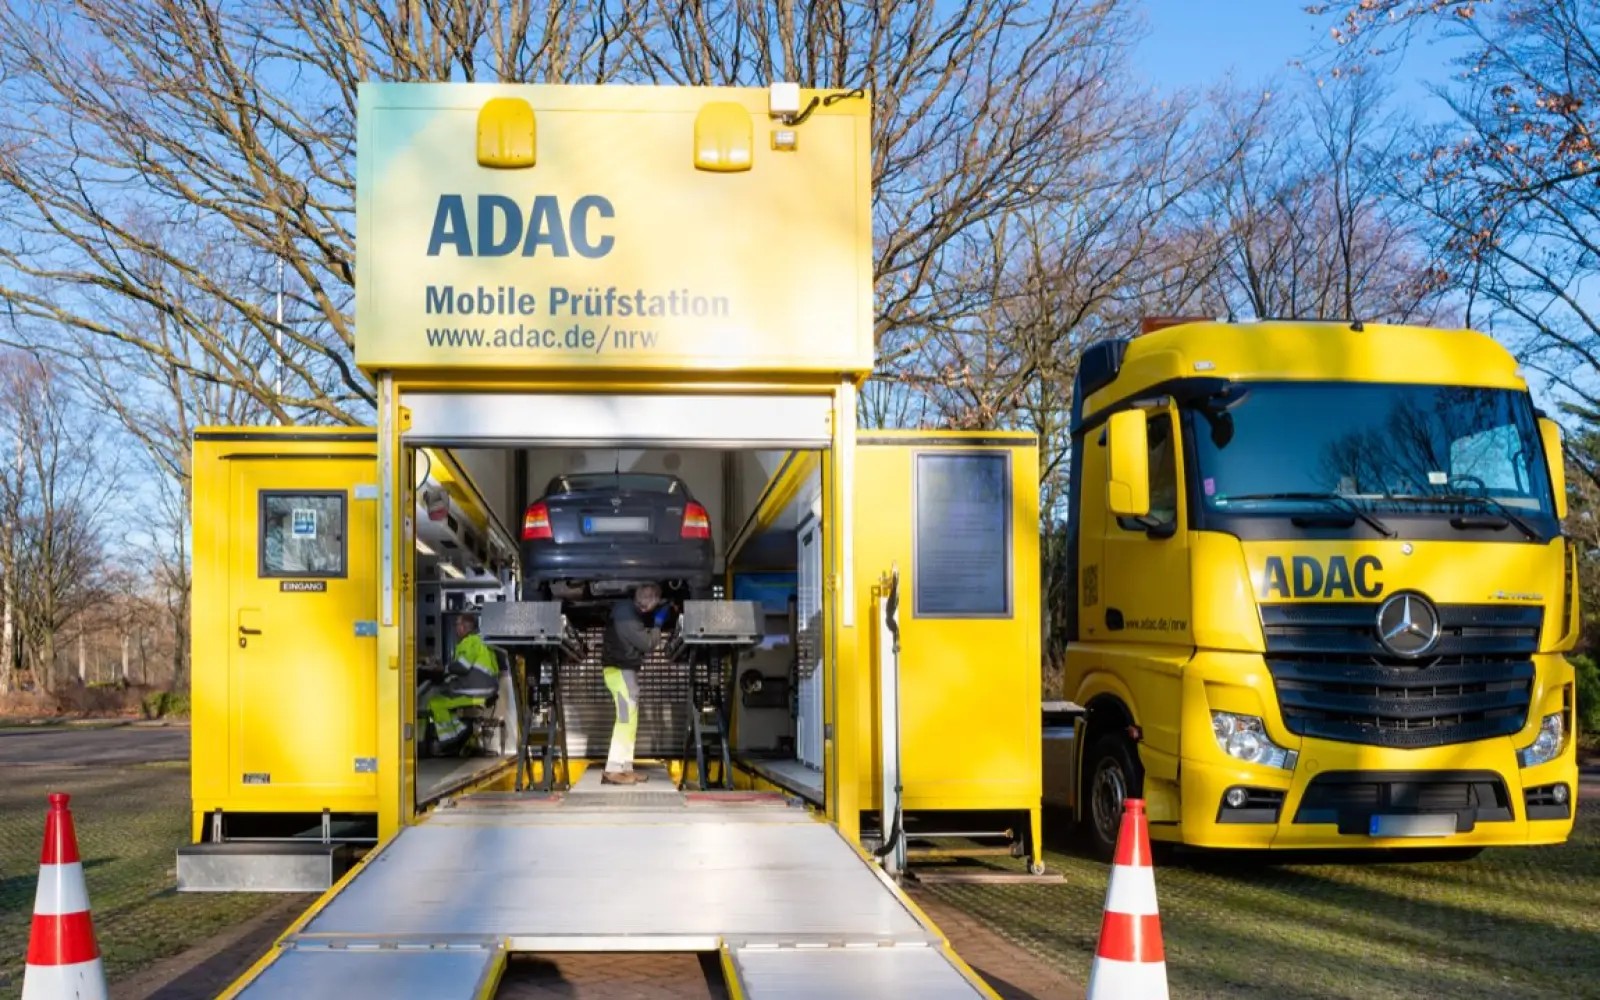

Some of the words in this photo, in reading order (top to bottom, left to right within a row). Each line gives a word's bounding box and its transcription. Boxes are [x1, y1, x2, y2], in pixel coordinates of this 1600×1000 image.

[426, 194, 615, 258] ADAC
[425, 286, 536, 315] Mobile
[549, 287, 730, 317] Prüfstation
[426, 324, 660, 353] www.adac.de/nrw
[283, 582, 324, 591] EINGANG
[1262, 555, 1383, 598] ADAC
